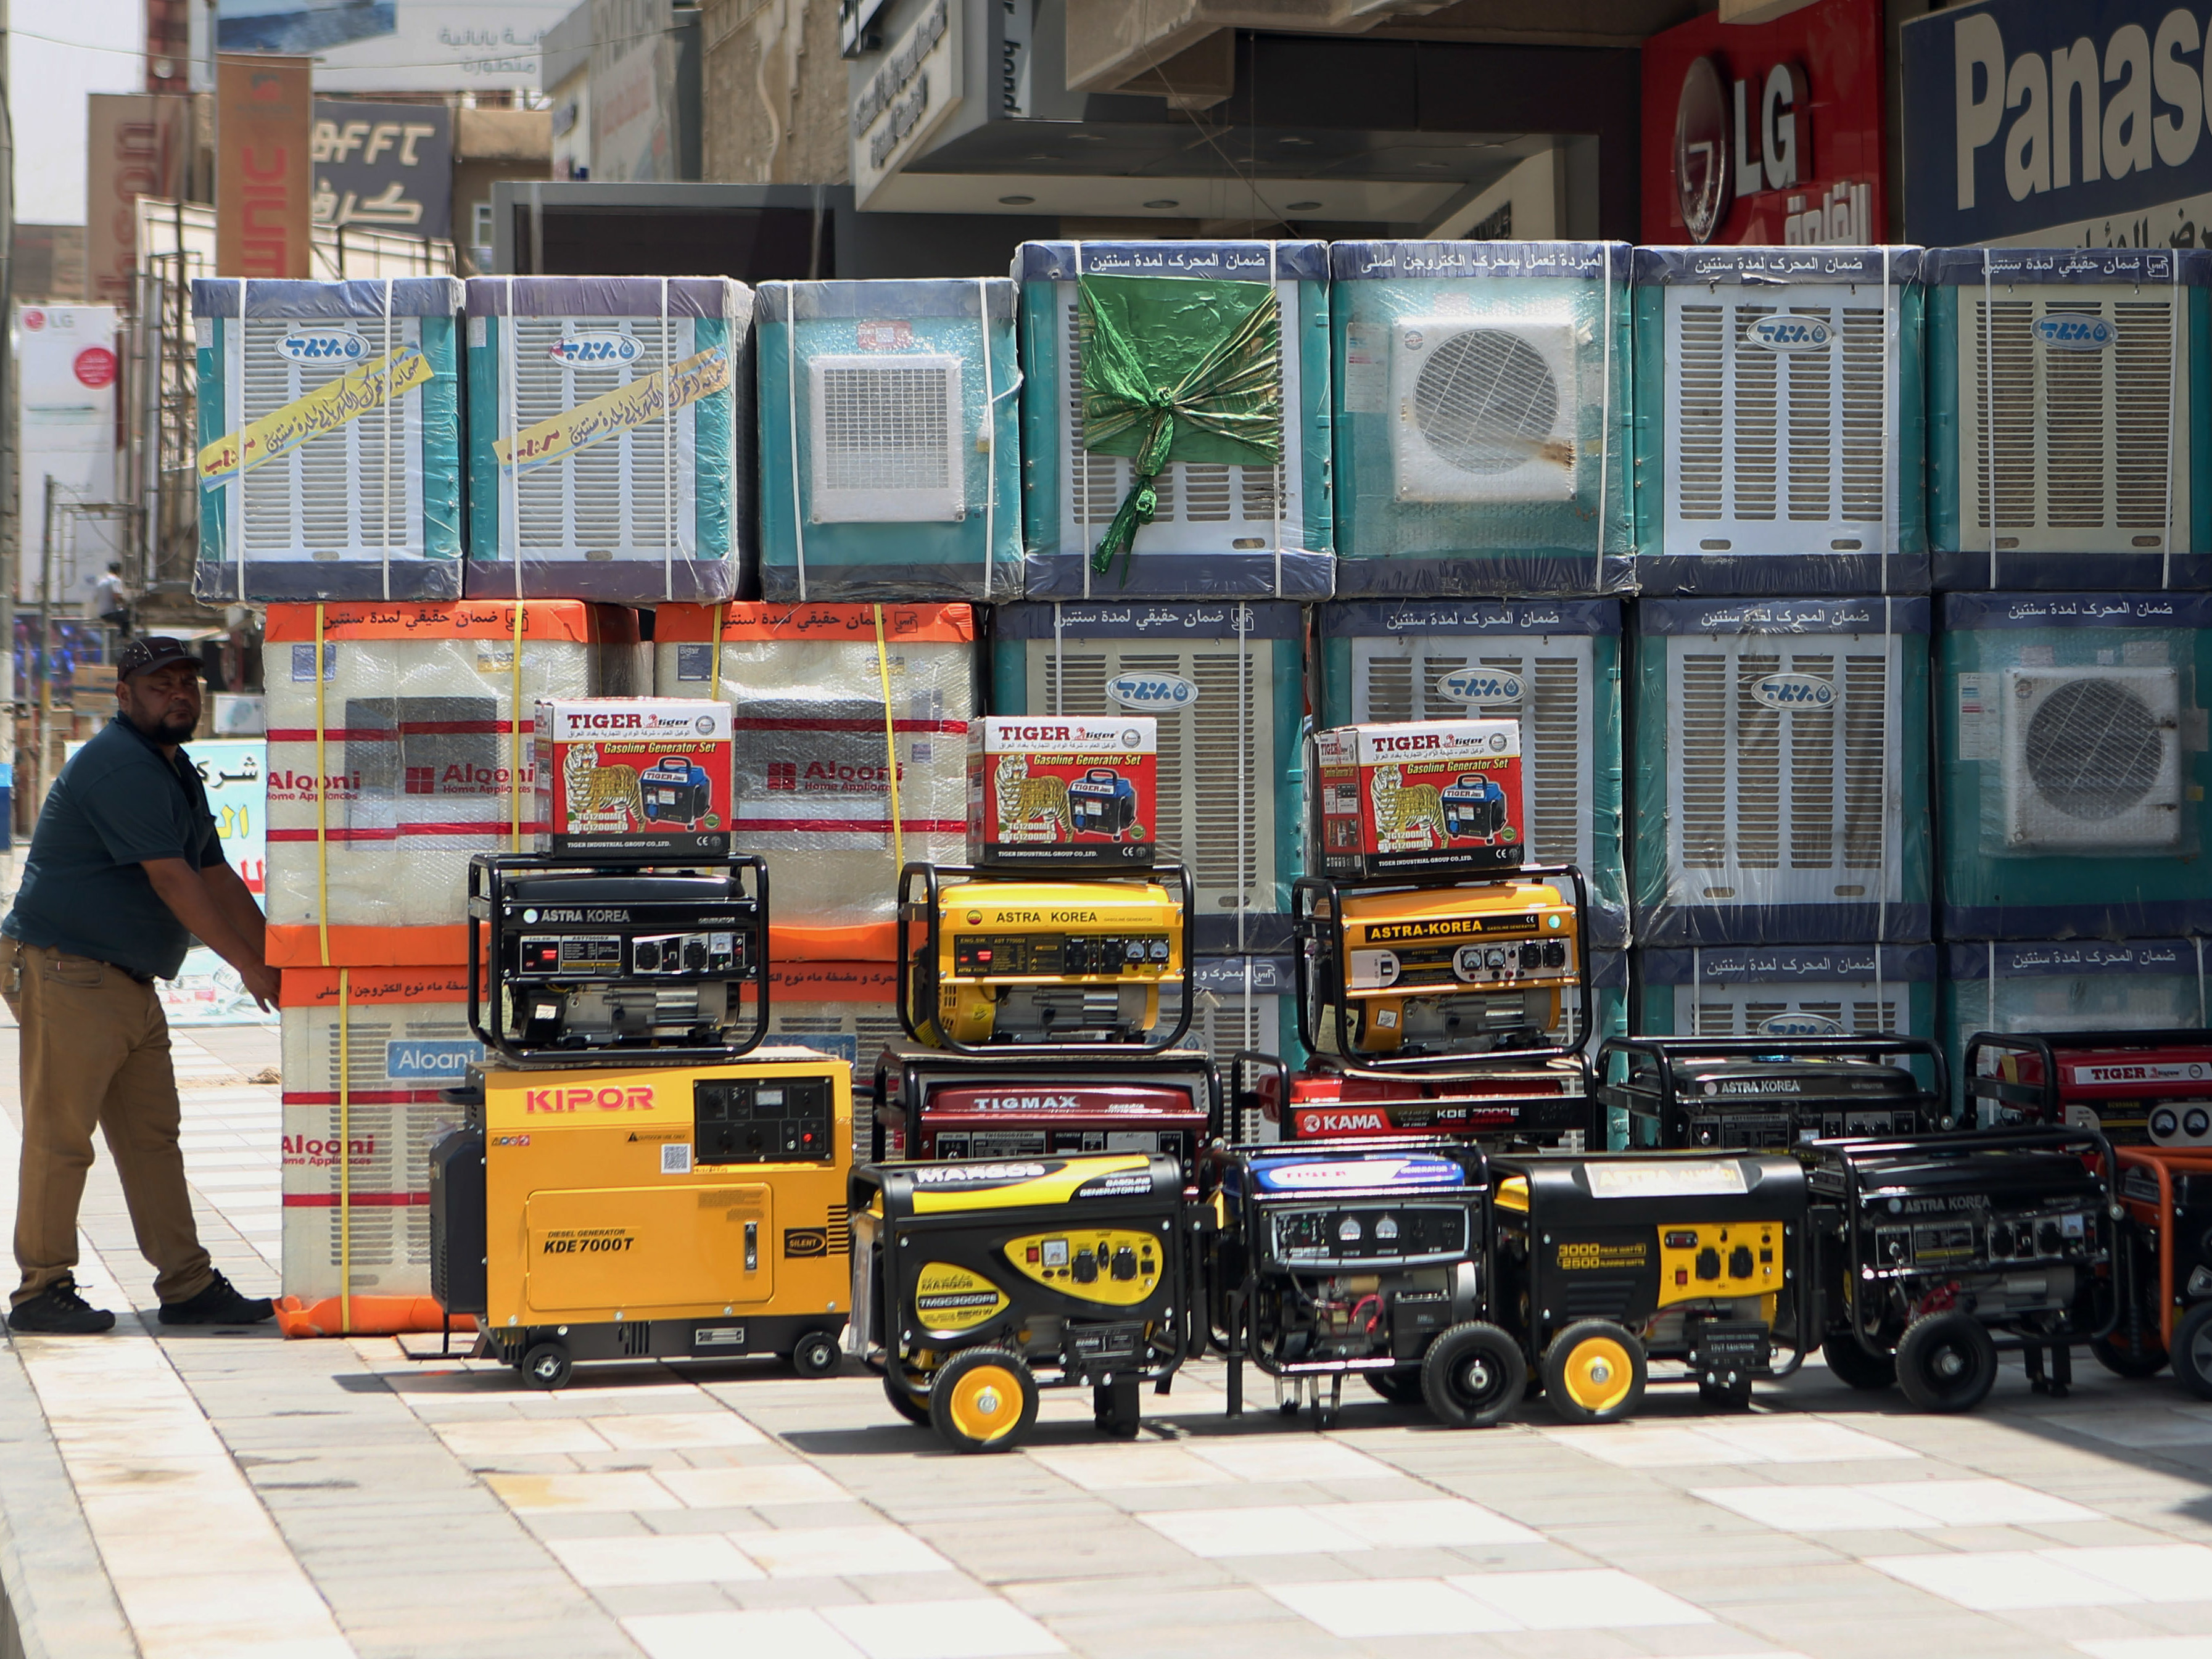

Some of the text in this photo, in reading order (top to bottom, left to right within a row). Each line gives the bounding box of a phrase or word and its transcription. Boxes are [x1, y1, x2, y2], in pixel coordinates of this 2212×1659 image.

[1954, 9, 2212, 211] Panas
[1735, 64, 1797, 199] LG
[1090, 255, 1129, 271] سنتين
[1134, 253, 1163, 268] لمدة
[1226, 253, 1265, 270] ضمان
[1695, 258, 1733, 273] سنتين
[1737, 257, 1765, 271] لمدة
[1825, 257, 1863, 273] ضمان
[2026, 256, 2053, 271] لمدة
[2058, 257, 2099, 278] حقيقي
[2103, 257, 2141, 274] ضمان
[1102, 609, 1131, 624] لمدة
[1744, 609, 1771, 623] لمدة
[1832, 608, 1870, 625] ضمان
[2008, 604, 2046, 619] سنتين
[2050, 603, 2077, 615] لمدة
[2137, 601, 2173, 617] ضمان
[322, 609, 498, 630] ضمان حقيقي لمدة سنتين
[762, 612, 793, 625] لمدة
[797, 612, 841, 631] حقيقي
[1136, 609, 1179, 630] حقيقي
[1184, 609, 1224, 627] ضمان
[1387, 614, 1426, 630] سنتين
[1430, 612, 1458, 626] لمدة
[1520, 610, 1559, 627] ضمان
[1701, 611, 1739, 627] سنتين
[567, 714, 642, 729] TIGER
[999, 726, 1070, 741] TIGER
[604, 741, 717, 755] Gasoline Generator Set
[1371, 735, 1441, 752] TIGER
[1034, 754, 1142, 767] Gasoline Generator Set
[1406, 758, 1509, 775] Gasoline Generator Set
[444, 785, 476, 794] Home
[805, 782, 838, 791] Home
[541, 908, 630, 923] ASTRA KOREA
[996, 911, 1098, 923] ASTRA KOREA
[1370, 920, 1483, 940] ASTRA-KOREA
[1750, 958, 1777, 972] لمدة
[2012, 952, 2050, 968] سنتين
[2055, 950, 2081, 964] لمدة
[2139, 949, 2176, 966] ضمان
[1707, 960, 1746, 976] سنتين
[1837, 958, 1875, 974] ضمان
[2090, 1066, 2147, 1081] TIGER
[1721, 1080, 1801, 1094] ASTRA KOREA
[526, 1086, 655, 1114] KIPOR
[974, 1095, 1079, 1111] TIGMAX
[1437, 1108, 1466, 1119] KDE
[1324, 1114, 1382, 1131] KAMA
[1905, 1195, 1991, 1214] ASTRA KOREA
[789, 1237, 817, 1249] SILENT
